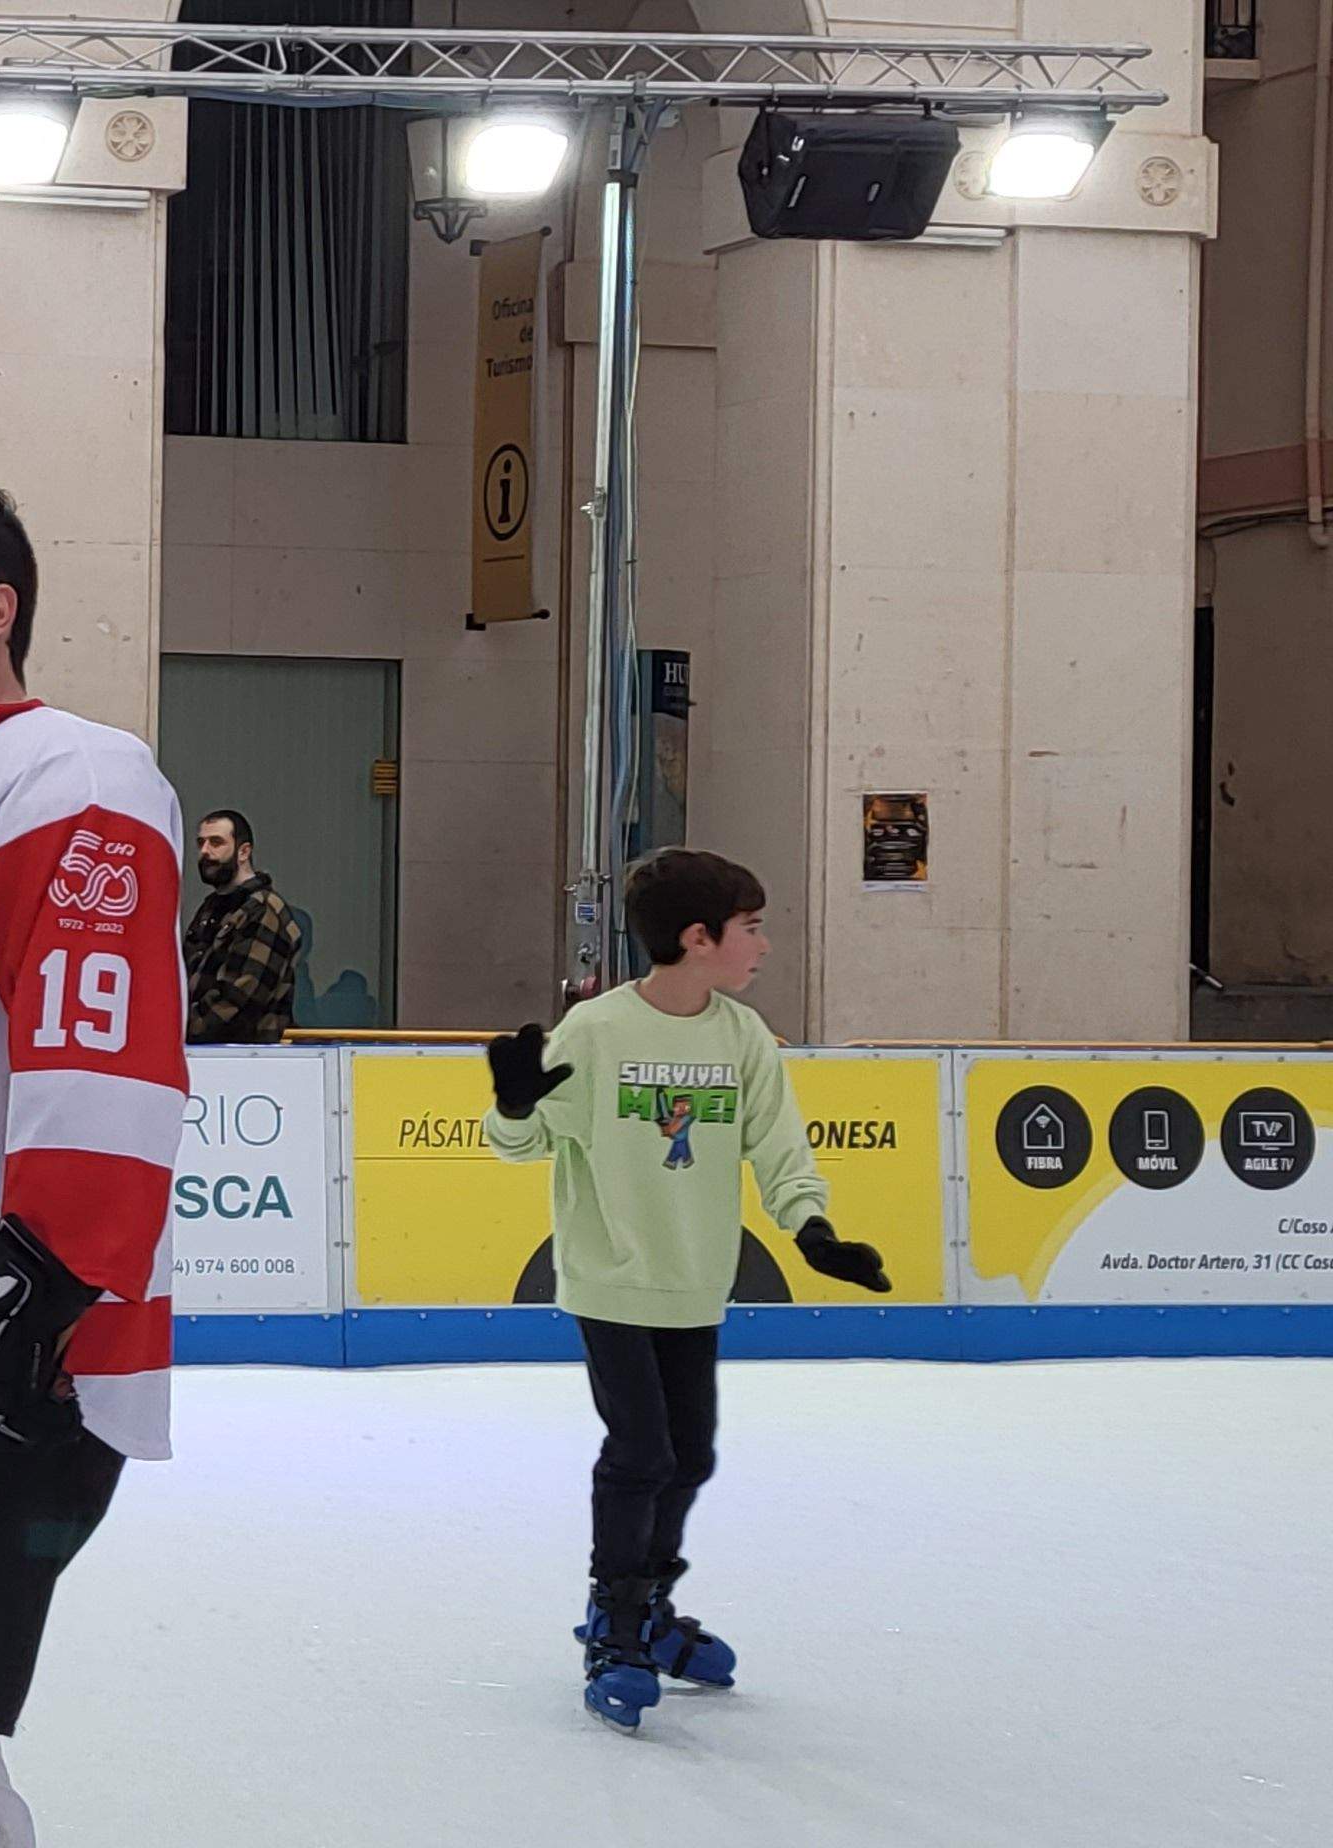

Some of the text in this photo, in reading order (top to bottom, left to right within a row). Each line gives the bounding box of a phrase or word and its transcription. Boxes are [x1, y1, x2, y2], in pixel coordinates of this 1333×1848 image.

[33, 948, 133, 1054] 19
[618, 1061, 738, 1087] SURVIVAL
[806, 1120, 897, 1149] ONESA
[1025, 1156, 1063, 1171] FIBRA
[1137, 1154, 1178, 1171] MÓVIL
[1244, 1157, 1294, 1171] AGILE TV
[1278, 1217, 1328, 1234] C/Coso
[195, 1259, 225, 1274] 974
[230, 1259, 259, 1274] 600
[264, 1259, 295, 1274] 008
[1101, 1253, 1143, 1270] Avda.
[1147, 1253, 1195, 1270] Doctor
[1198, 1253, 1249, 1272] Artero,
[1253, 1254, 1271, 1270] 31
[1276, 1253, 1301, 1273] (CC
